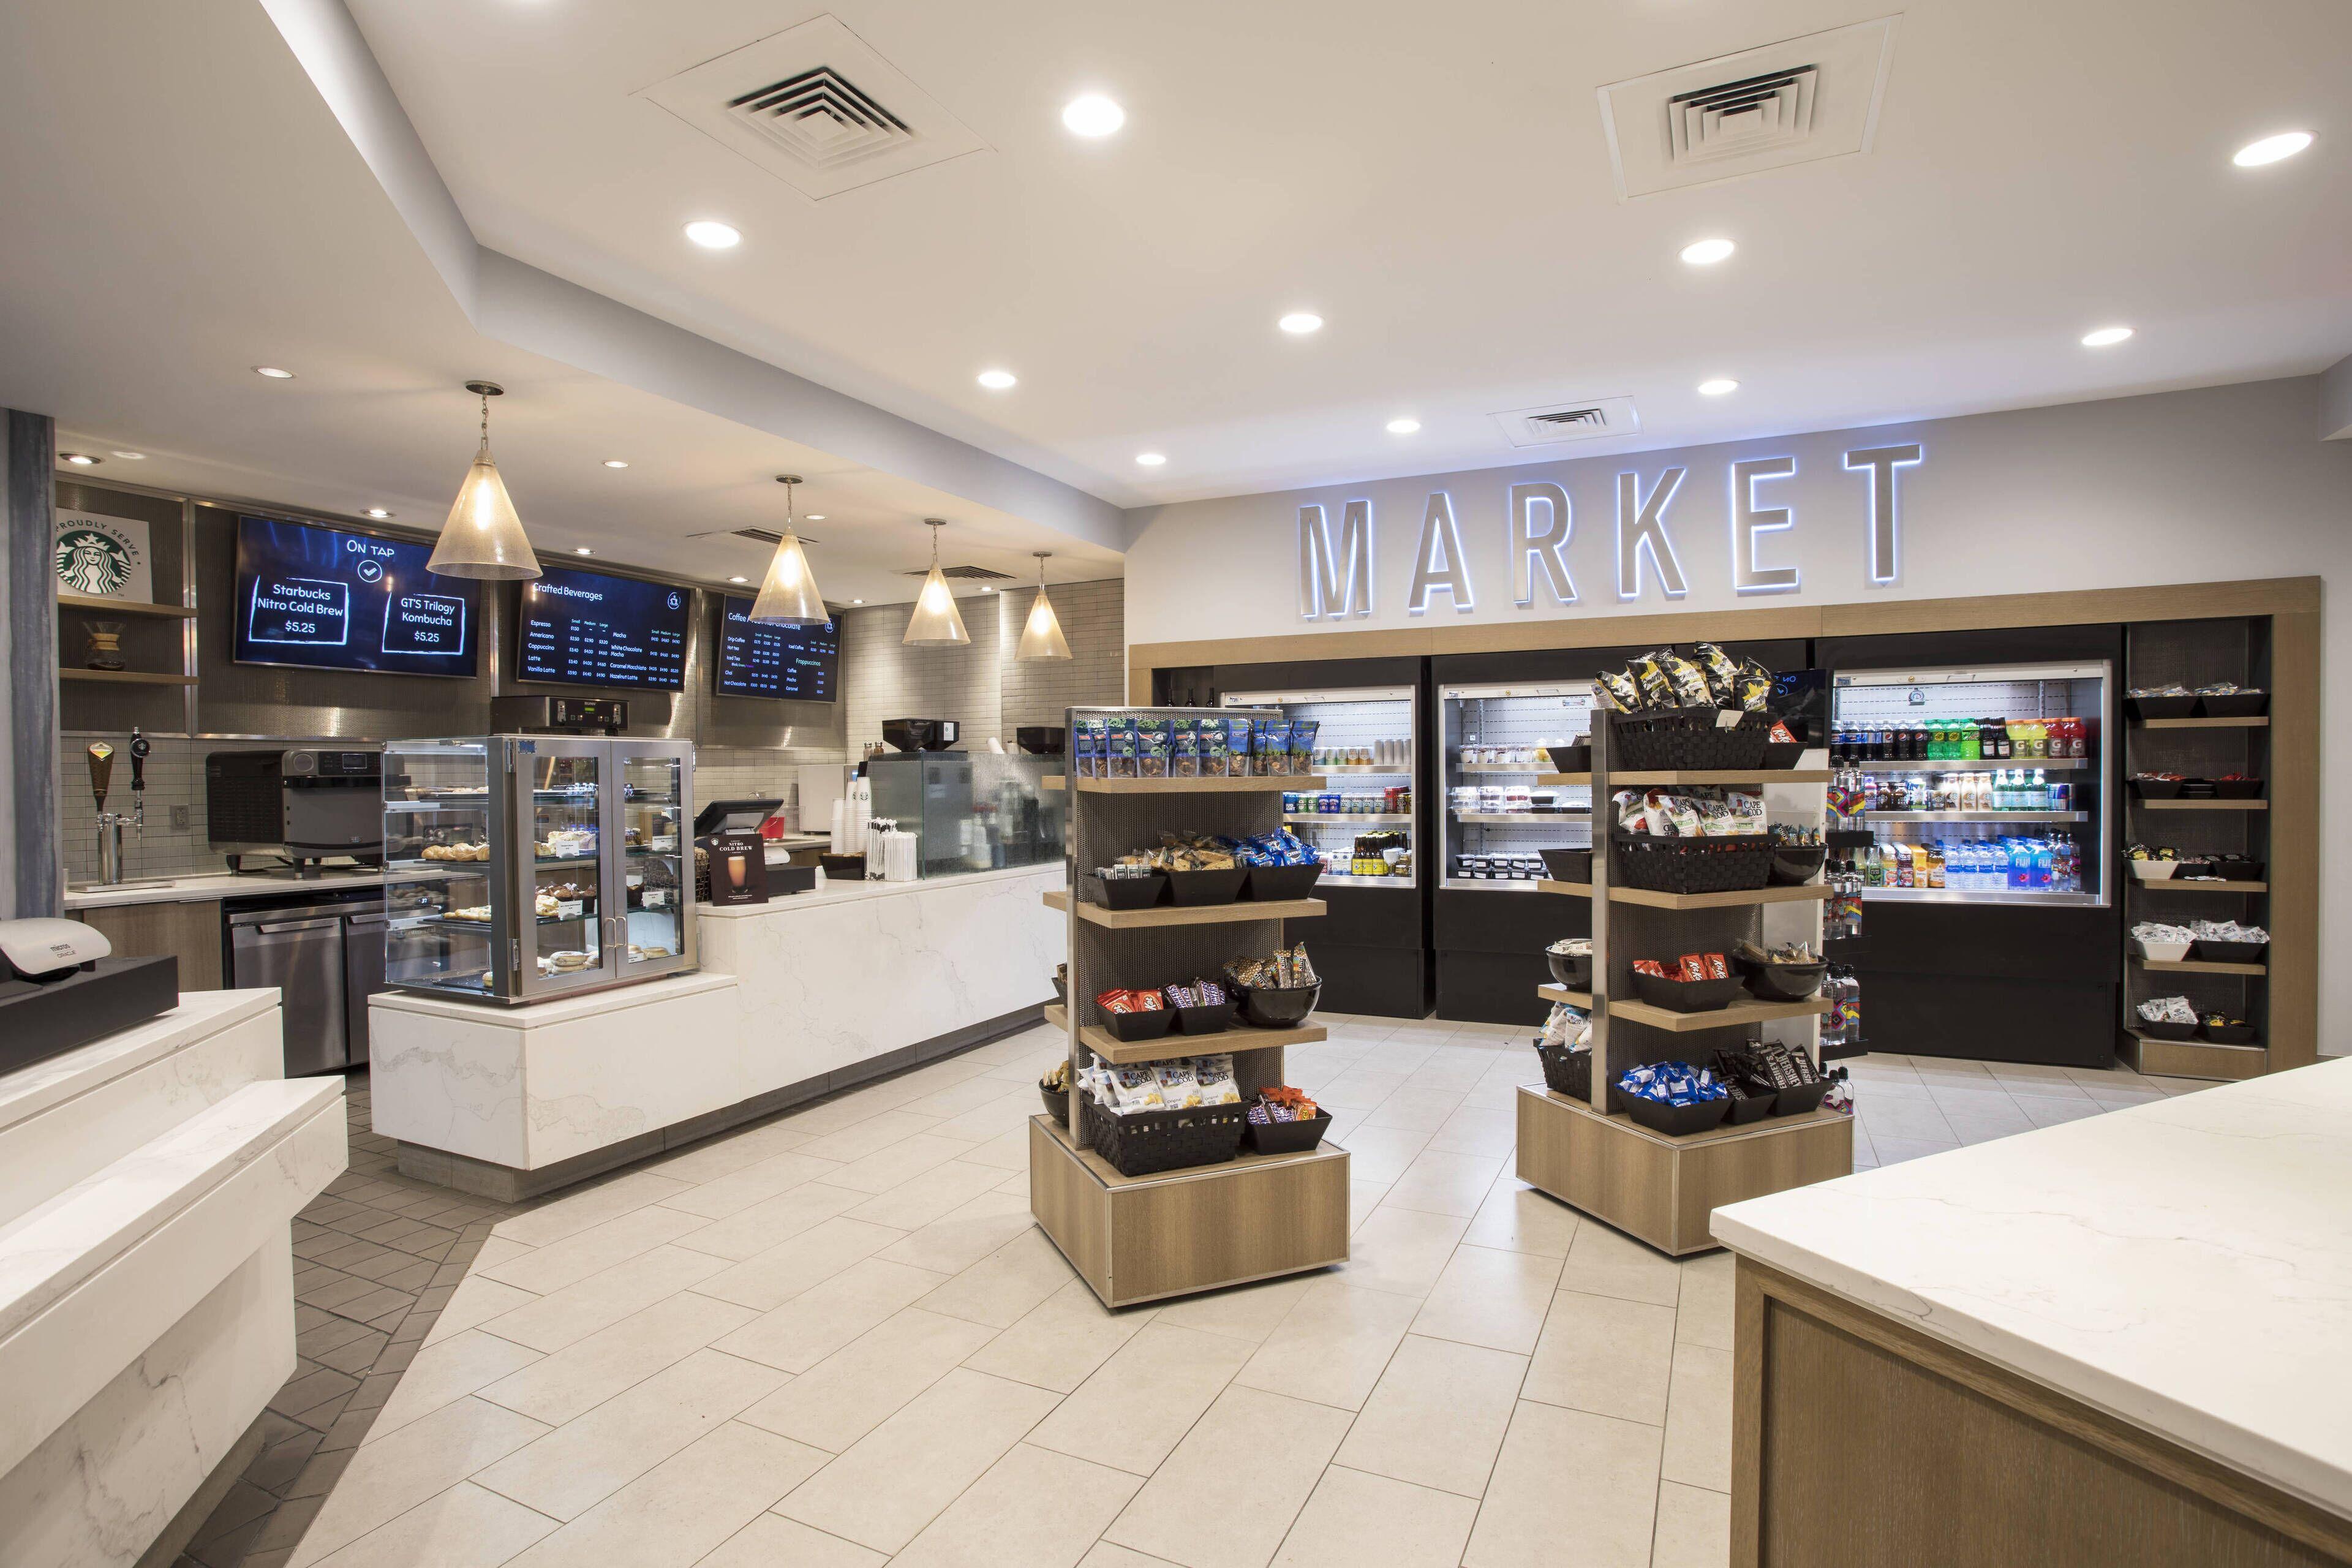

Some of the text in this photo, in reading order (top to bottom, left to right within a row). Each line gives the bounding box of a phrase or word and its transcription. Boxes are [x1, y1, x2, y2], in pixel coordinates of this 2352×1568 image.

[1299, 443, 1921, 616] MARKET
[111, 529, 139, 556] SERVE
[347, 540, 394, 557] ON TAP
[273, 584, 330, 600] Starbucks
[533, 583, 602, 601] Crafted Beverages
[258, 598, 343, 616] Nitro Cold Brew
[424, 600, 455, 614] Trilogy
[403, 612, 452, 626] Kombucha
[728, 612, 746, 622] Coffee
[285, 620, 315, 633] $5.25
[415, 631, 439, 643] $5.25
[1255, 973, 1265, 986] KIND
[1131, 1071, 1148, 1080] CAPE
[1173, 1071, 1191, 1079] CAPE
[1766, 1053, 1787, 1089] ERSHEY'S
[1779, 1055, 1803, 1087] HERSHEY
[1135, 1077, 1152, 1085] COD
[1177, 1076, 1193, 1084] COD
